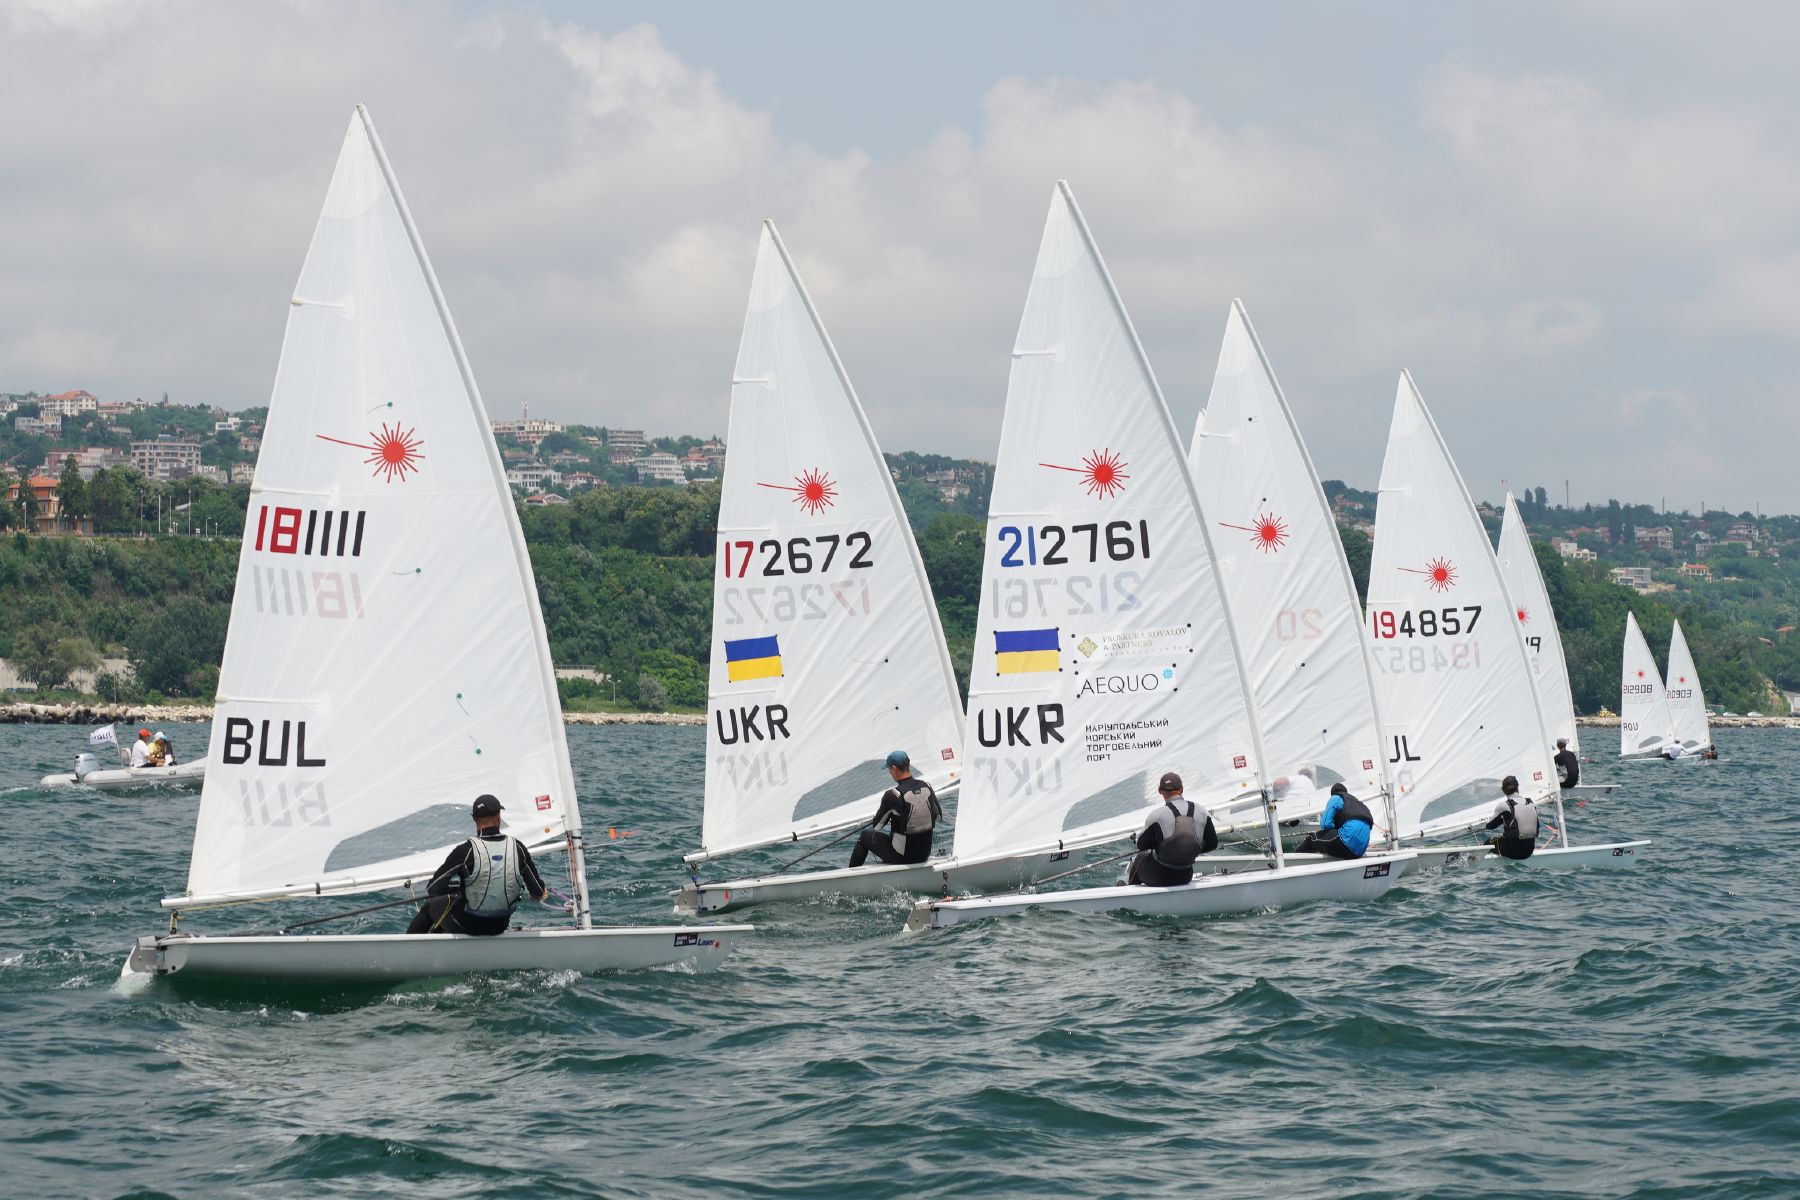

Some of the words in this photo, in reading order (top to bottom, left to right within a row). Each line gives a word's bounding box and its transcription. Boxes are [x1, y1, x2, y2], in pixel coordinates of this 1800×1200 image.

[255, 505, 366, 557] 181111
[725, 531, 873, 578] 172672
[998, 519, 1151, 568] 212761
[1147, 627, 1188, 639] KOVALOV
[1373, 605, 1482, 639] 194857
[1112, 639, 1153, 651] PARTNERS
[1080, 673, 1159, 695] AEQUO
[1623, 684, 1653, 694] 212908
[716, 703, 791, 745] UKR
[977, 703, 1065, 748] UKR
[1623, 722, 1639, 731] ROU
[222, 717, 326, 768] BUL
[1085, 731, 1136, 742] МОРСЬКИЙ
[1086, 739, 1162, 752] ТОРГОВЕЛЬНИЙ
[1086, 753, 1111, 762] ПОРТ
